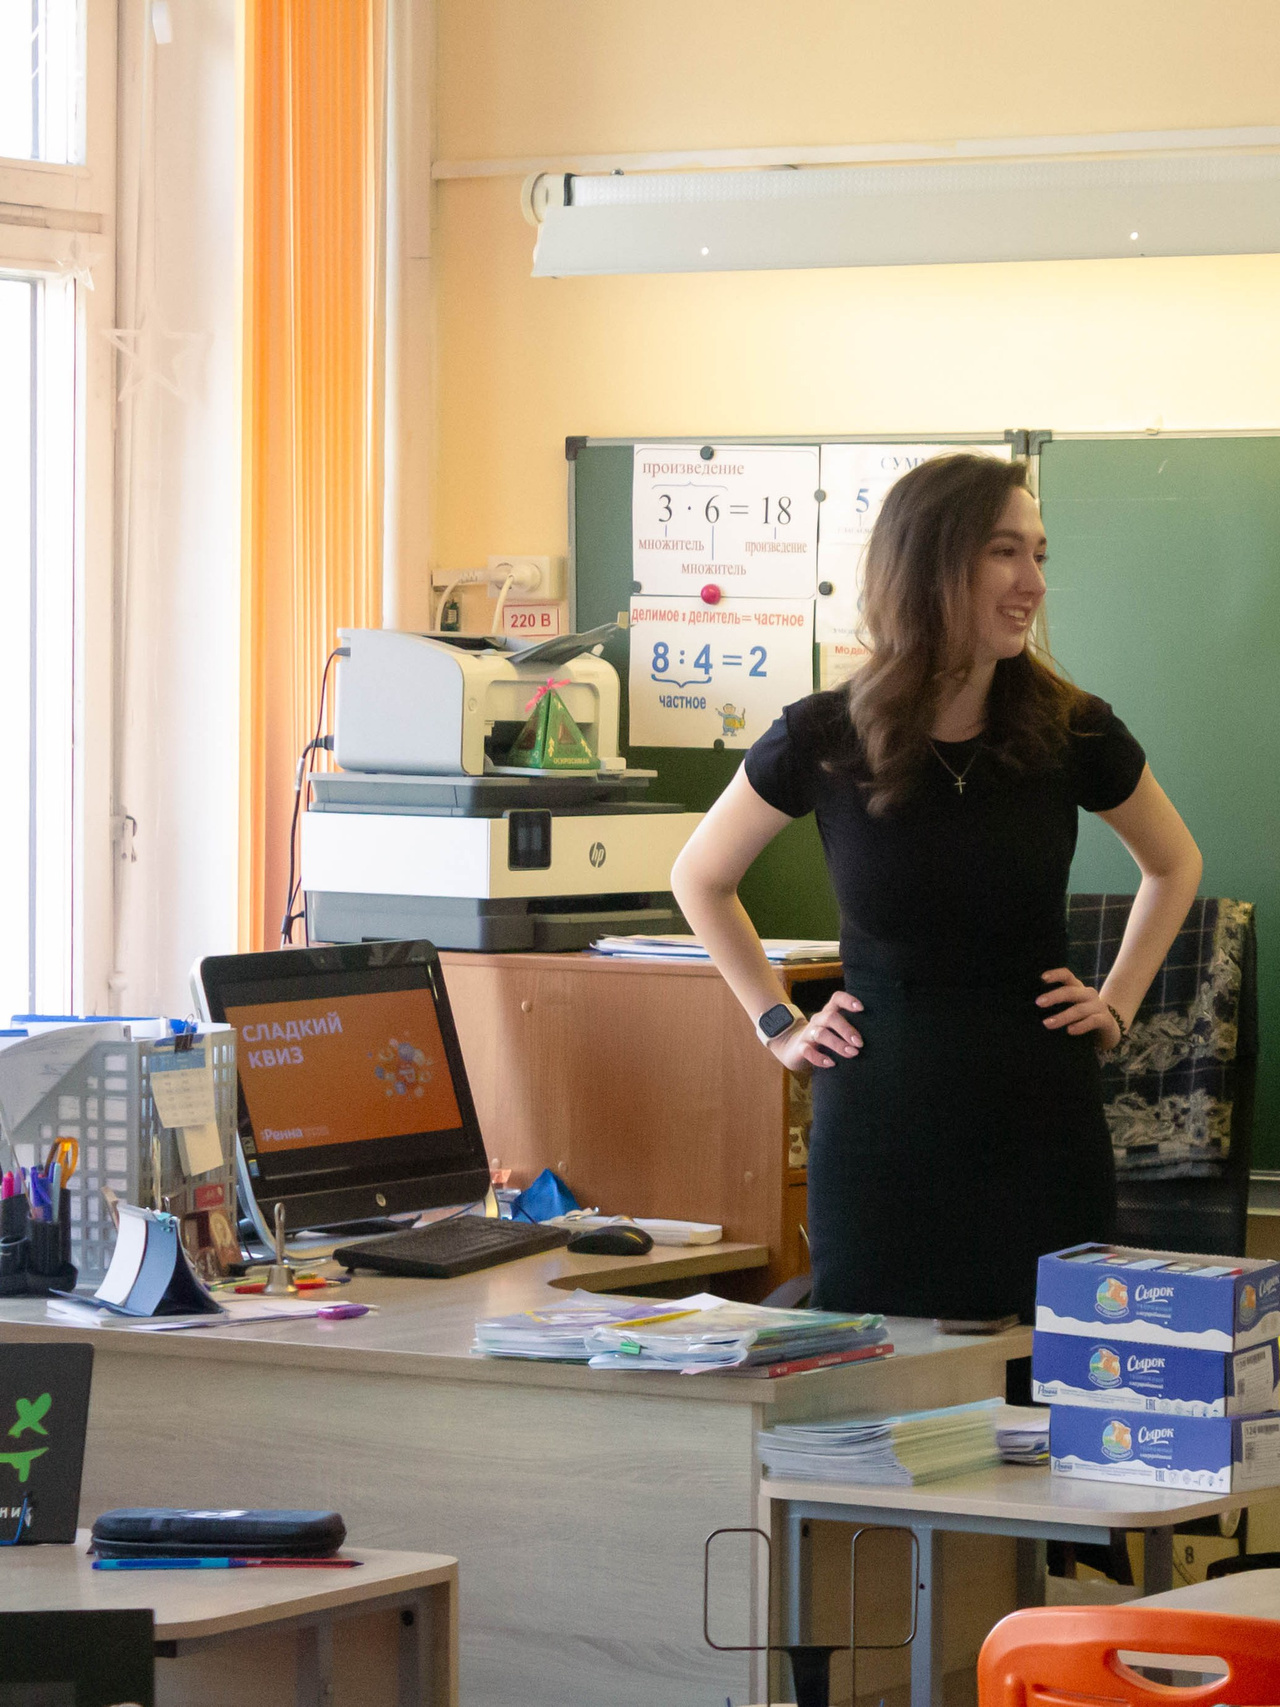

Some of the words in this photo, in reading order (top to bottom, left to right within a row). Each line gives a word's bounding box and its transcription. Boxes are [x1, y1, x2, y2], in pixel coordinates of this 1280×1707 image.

[642, 462, 745, 478] произведение
[881, 456, 926, 471] СУМ
[855, 487, 870, 513] 5
[658, 494, 673, 523] 3
[705, 494, 720, 524] 6
[762, 495, 792, 526] 18
[638, 538, 705, 552] множитель
[744, 540, 808, 557] произведение
[681, 562, 747, 576] множитель
[510, 613, 536, 628] 220
[540, 613, 551, 627] В
[631, 607, 680, 622] делимое
[688, 610, 741, 625] делитель
[754, 612, 805, 627] частное
[652, 641, 670, 673] 8
[693, 643, 714, 675] 4
[748, 645, 768, 677] 2
[658, 694, 707, 710] частное
[589, 842, 606, 868] hp
[241, 1011, 344, 1043] СЛАДКИЙ
[248, 1046, 305, 1069] КВИЗ
[1134, 1284, 1175, 1303] Сырок
[1127, 1355, 1166, 1374] Сырок
[1138, 1426, 1175, 1446] Сырок
